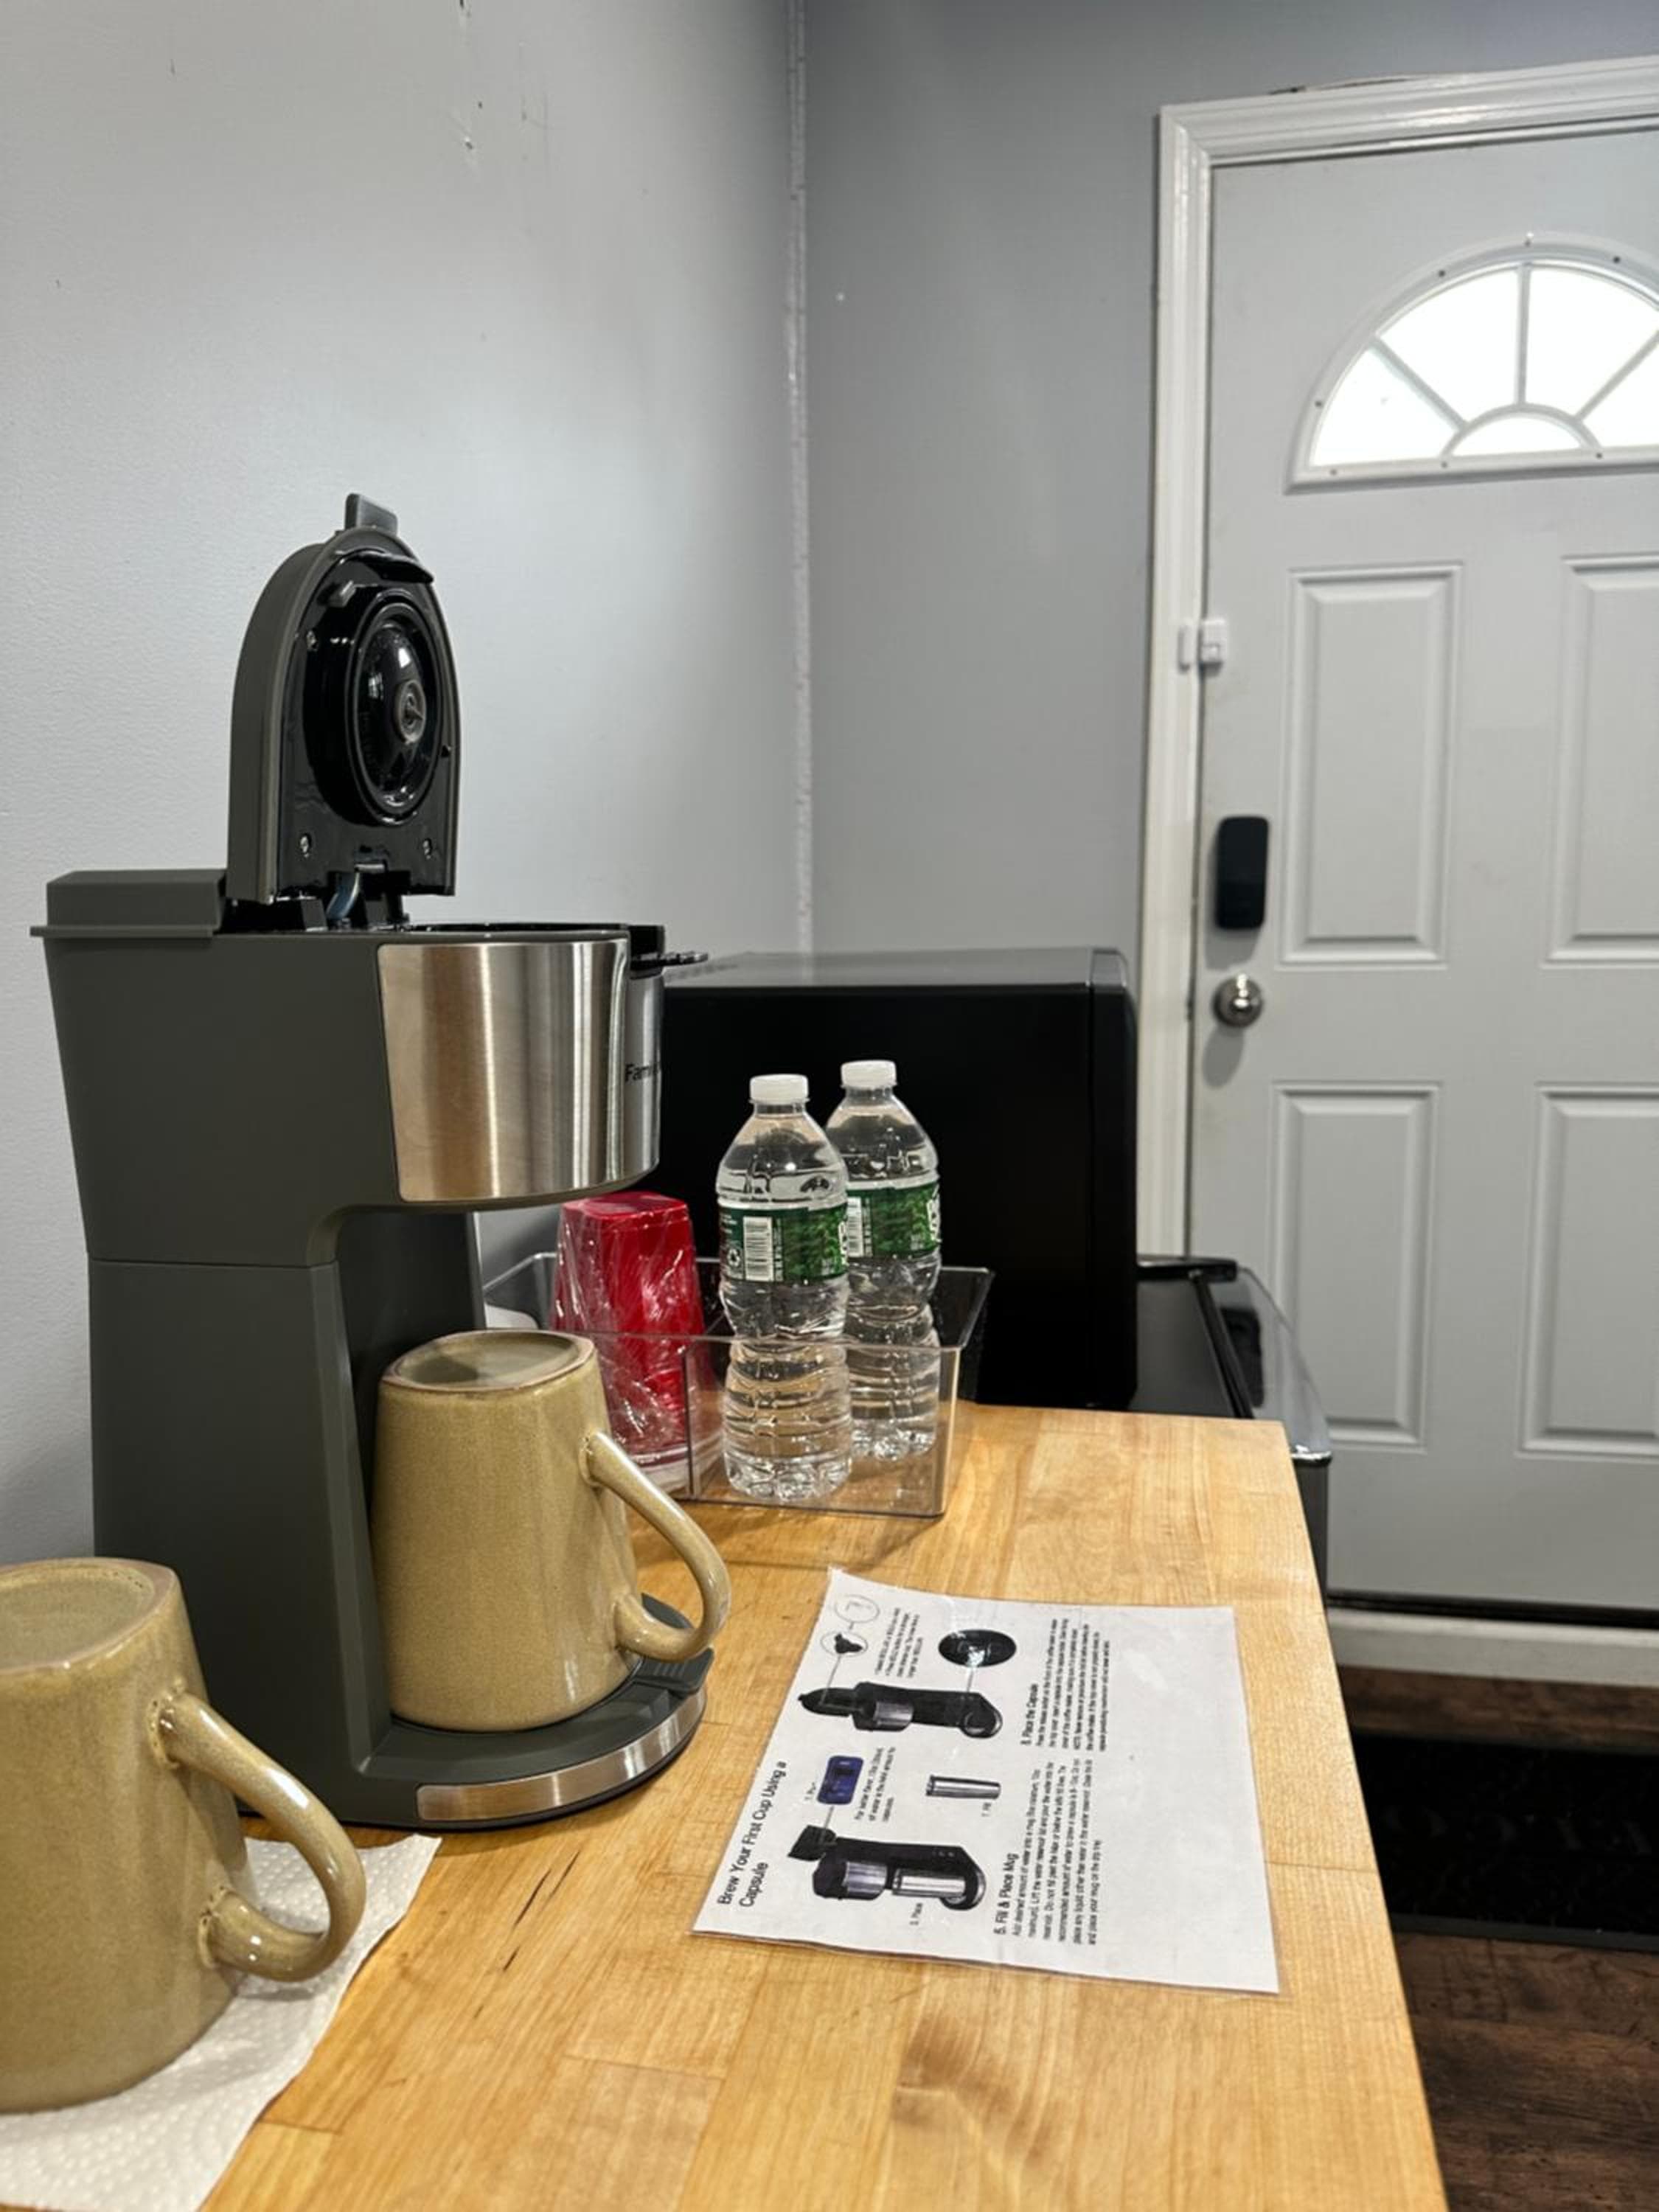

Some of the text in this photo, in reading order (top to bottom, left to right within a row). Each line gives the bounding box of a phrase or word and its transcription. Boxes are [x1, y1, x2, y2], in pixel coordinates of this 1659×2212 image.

[1026, 1684, 1038, 1708] Capsule
[761, 1770, 786, 1797] Using
[752, 1799, 773, 1820] Cup
[741, 1823, 762, 1845] First
[729, 1846, 751, 1872] Your
[1003, 1854, 1019, 1871] Mug
[717, 1876, 740, 1905] Brew
[739, 1863, 768, 1907] Capsule
[999, 1874, 1014, 1898] Place
